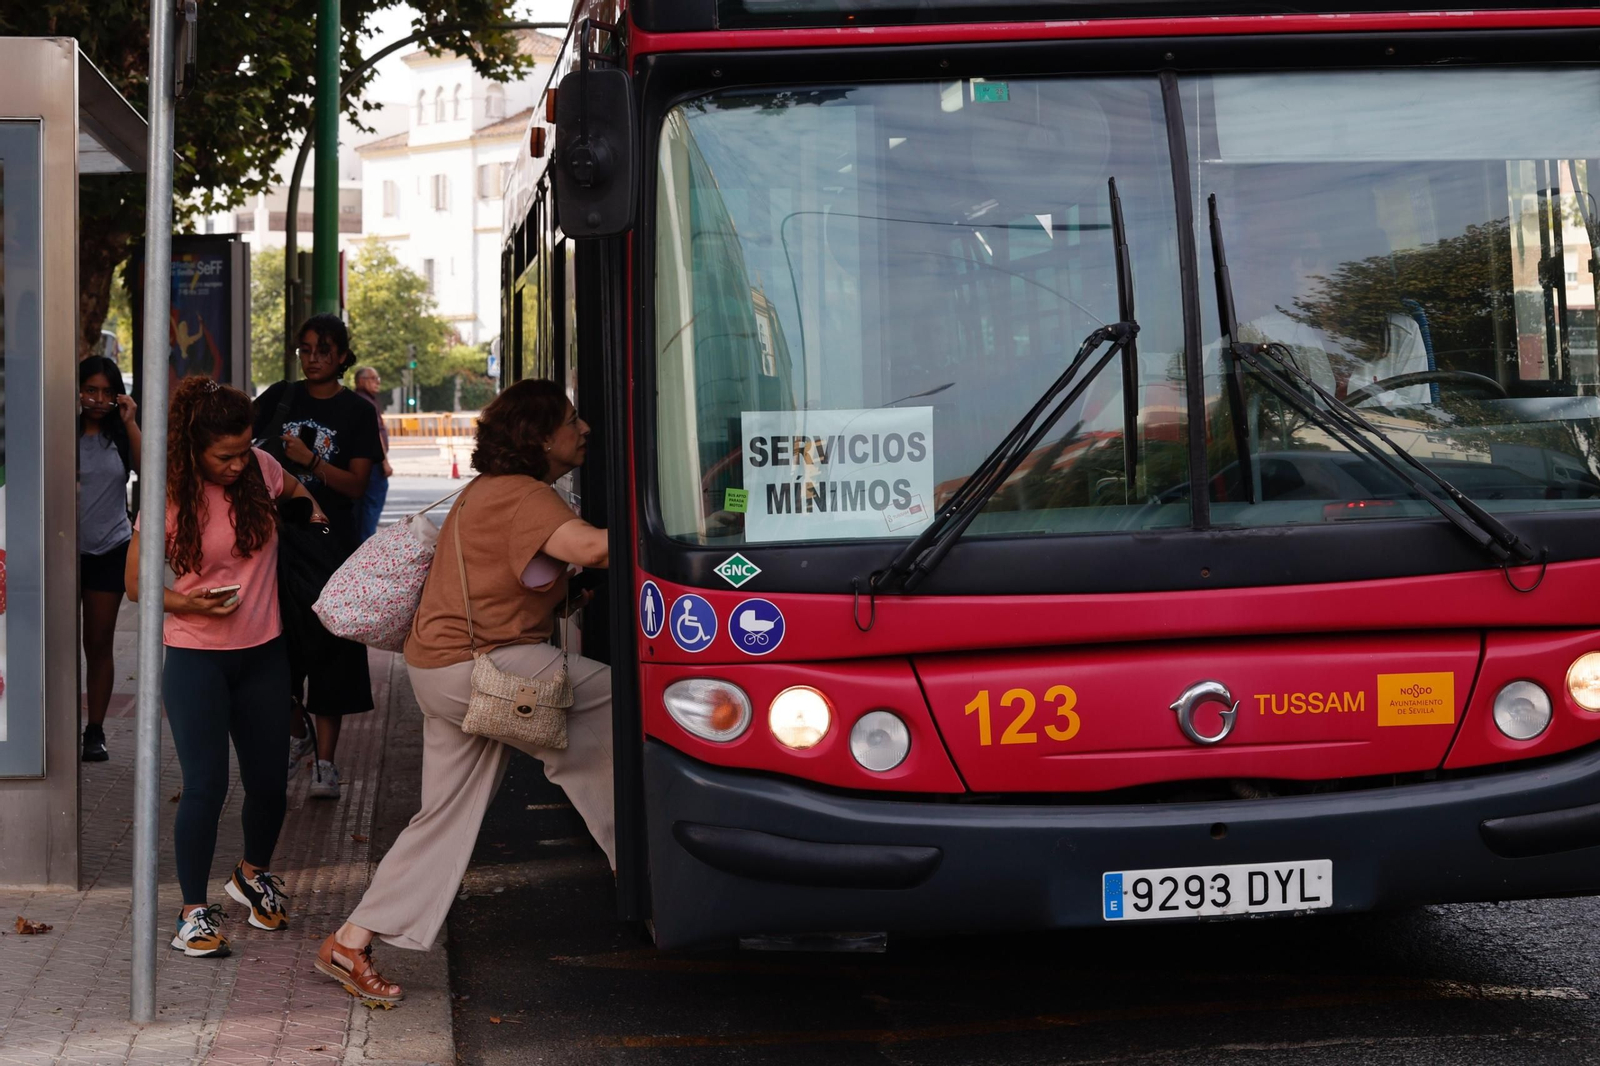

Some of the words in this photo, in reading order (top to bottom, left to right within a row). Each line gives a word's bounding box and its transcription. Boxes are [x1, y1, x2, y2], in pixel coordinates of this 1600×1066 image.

[197, 260, 222, 275] SeFF
[749, 432, 927, 468] SERVICIOS
[766, 475, 912, 515] MÍNIMOS
[721, 564, 752, 576] GNC
[964, 684, 1081, 746] 123
[1253, 690, 1365, 715] TUSSAM
[1131, 873, 1232, 912] 9293
[1248, 868, 1321, 906] DYL
[1110, 901, 1118, 911] E
